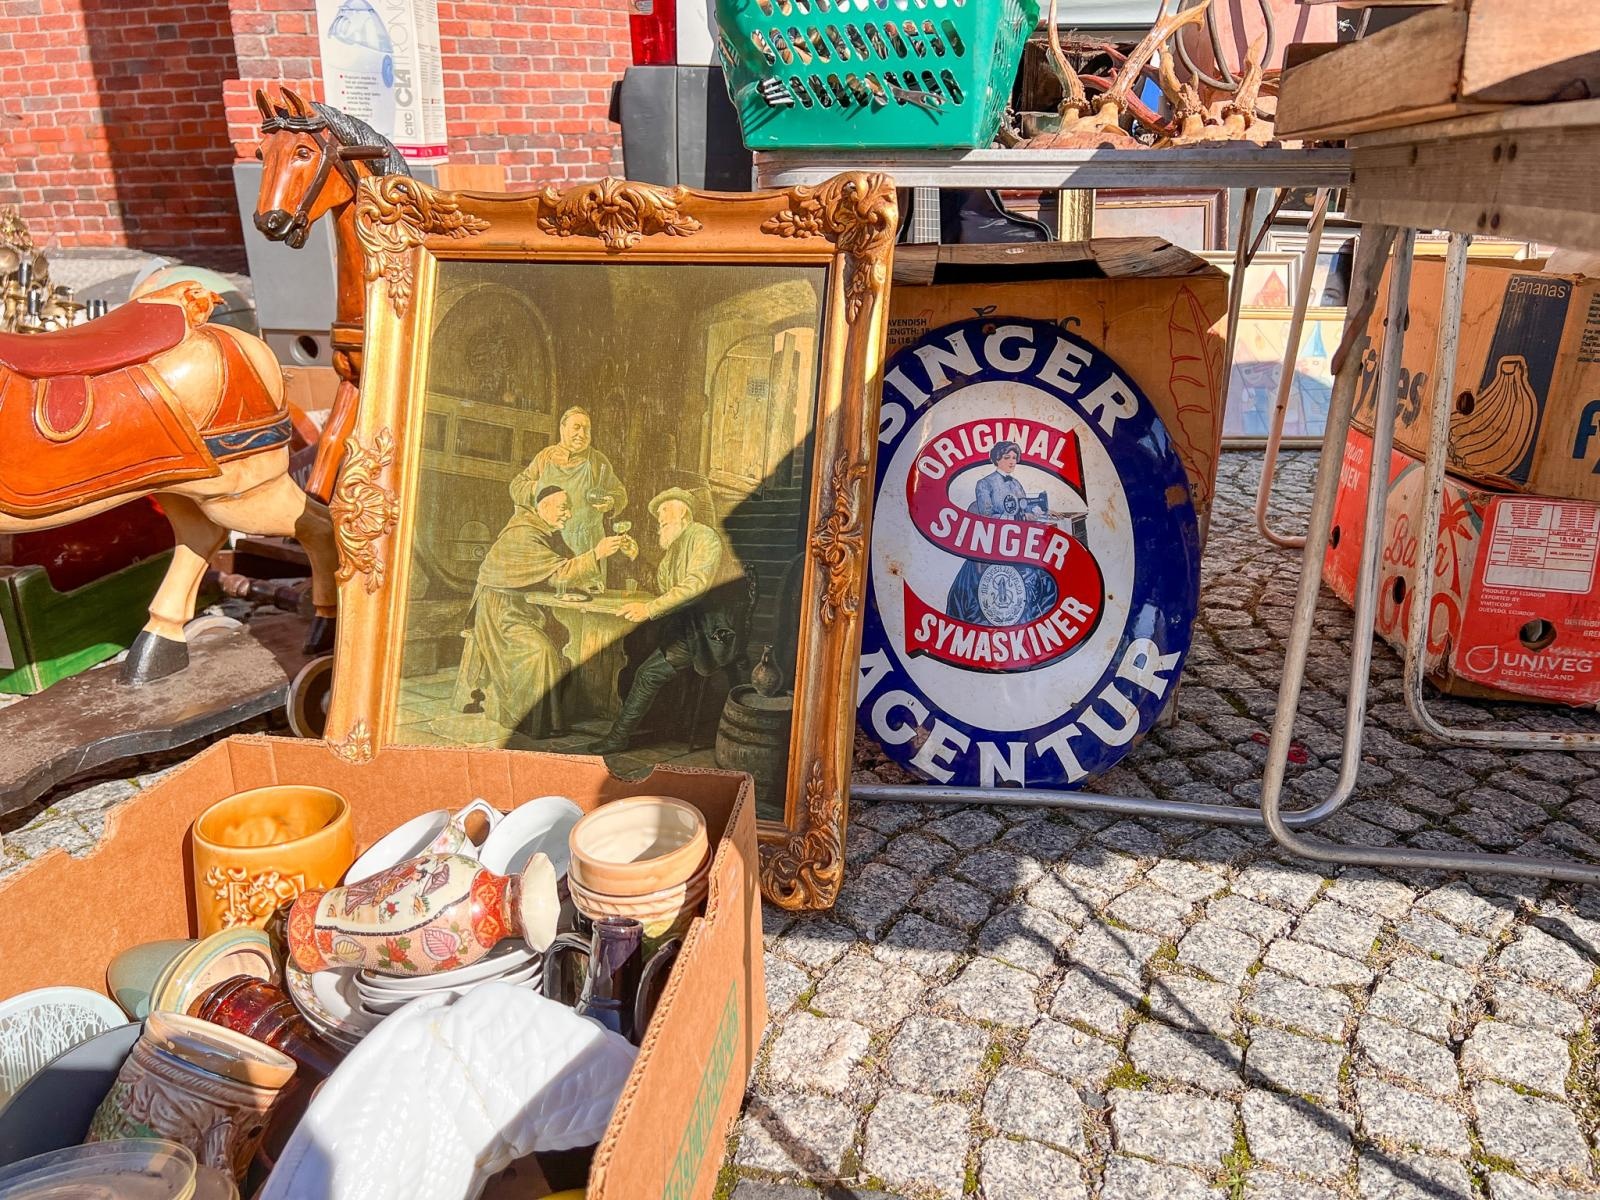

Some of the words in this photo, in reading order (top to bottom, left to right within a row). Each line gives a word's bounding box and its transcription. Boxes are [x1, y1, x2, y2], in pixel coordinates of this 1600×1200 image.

[878, 325, 1139, 445] SINGER
[918, 422, 1066, 481] ORIGINAL
[930, 507, 1070, 571] SINGER
[1480, 593, 1511, 601] EXPORTED
[1482, 587, 1509, 595] PRODUCT
[1519, 590, 1546, 598] ECUADOR
[914, 596, 1093, 663] SYMASKINER
[1501, 669, 1575, 681] DEUTSCHLAND
[1503, 652, 1593, 673] UNIVEG
[857, 637, 1181, 789] AGENTUR
